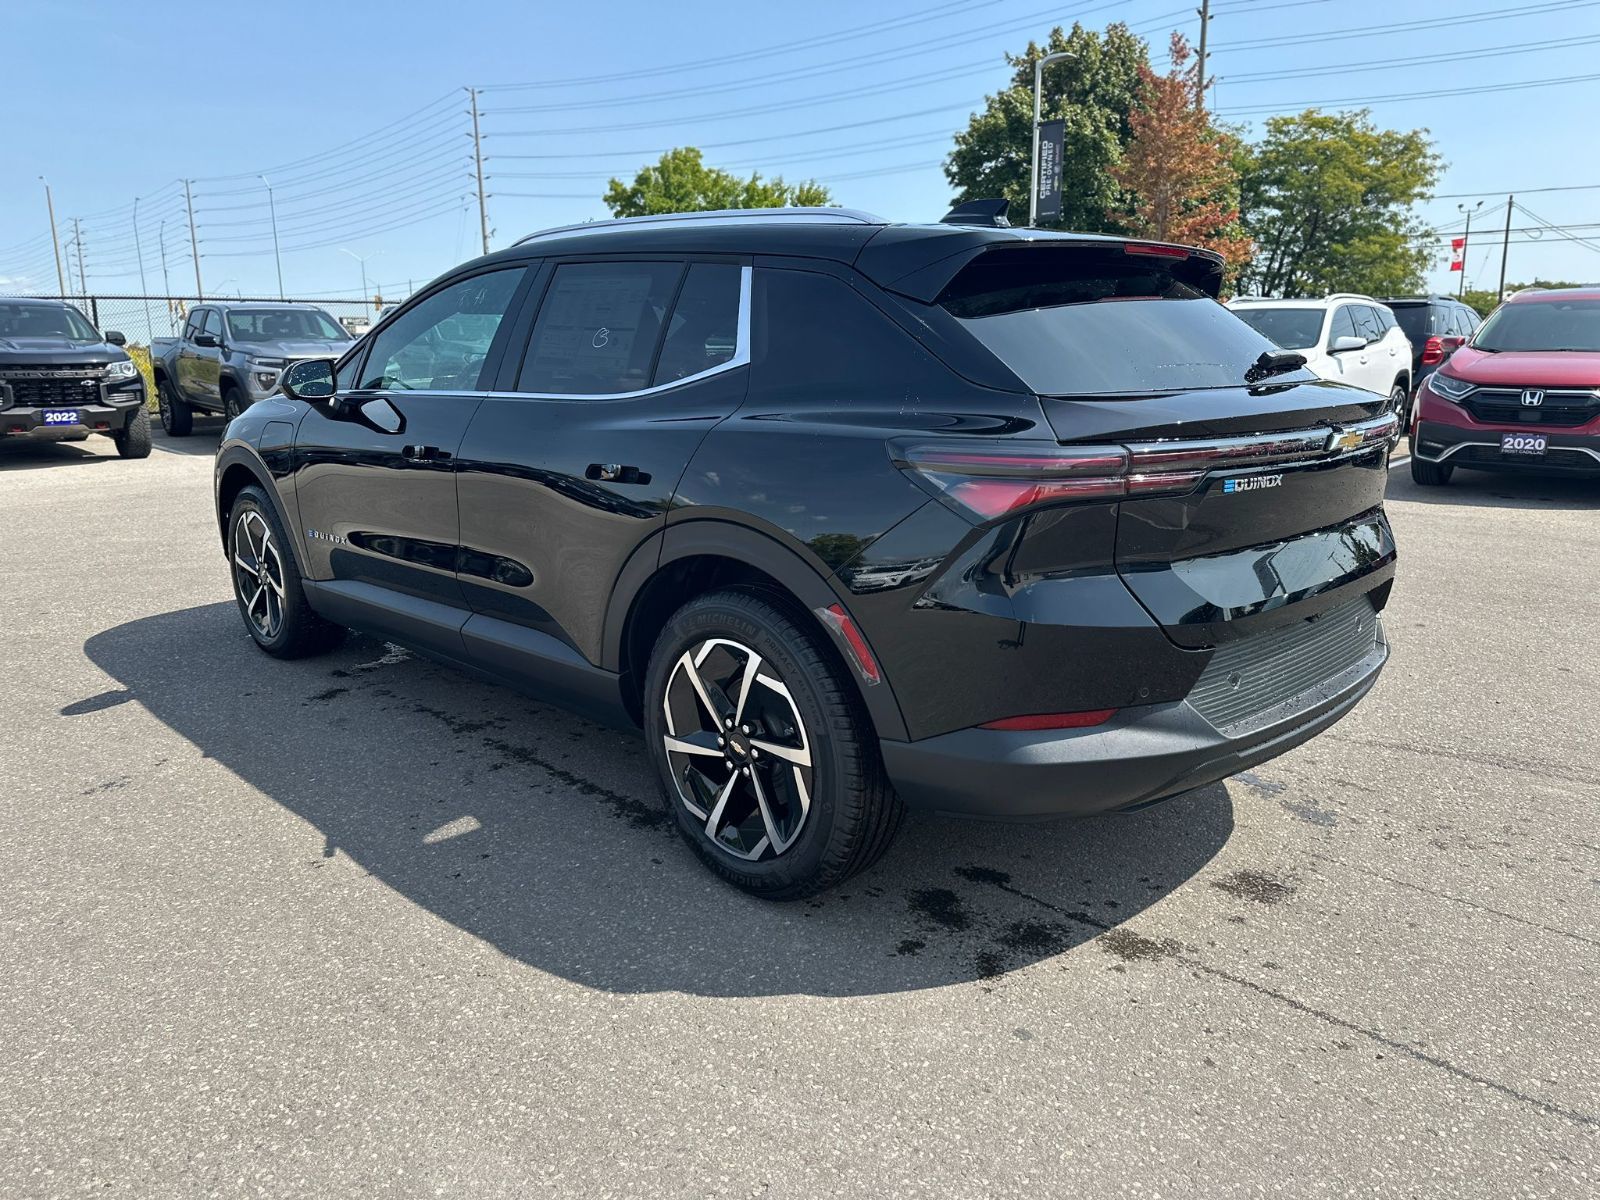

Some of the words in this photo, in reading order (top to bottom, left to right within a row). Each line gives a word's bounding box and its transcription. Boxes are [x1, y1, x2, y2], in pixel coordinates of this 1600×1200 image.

[1039, 140, 1048, 199] CERTIFIED
[45, 412, 77, 422] 2022
[1503, 437, 1545, 450] 2020
[1223, 474, 1283, 493] EQUINOX
[308, 529, 347, 545] EQUINOX
[697, 614, 757, 636] MICHELIN
[764, 638, 798, 675] PRIMACY
